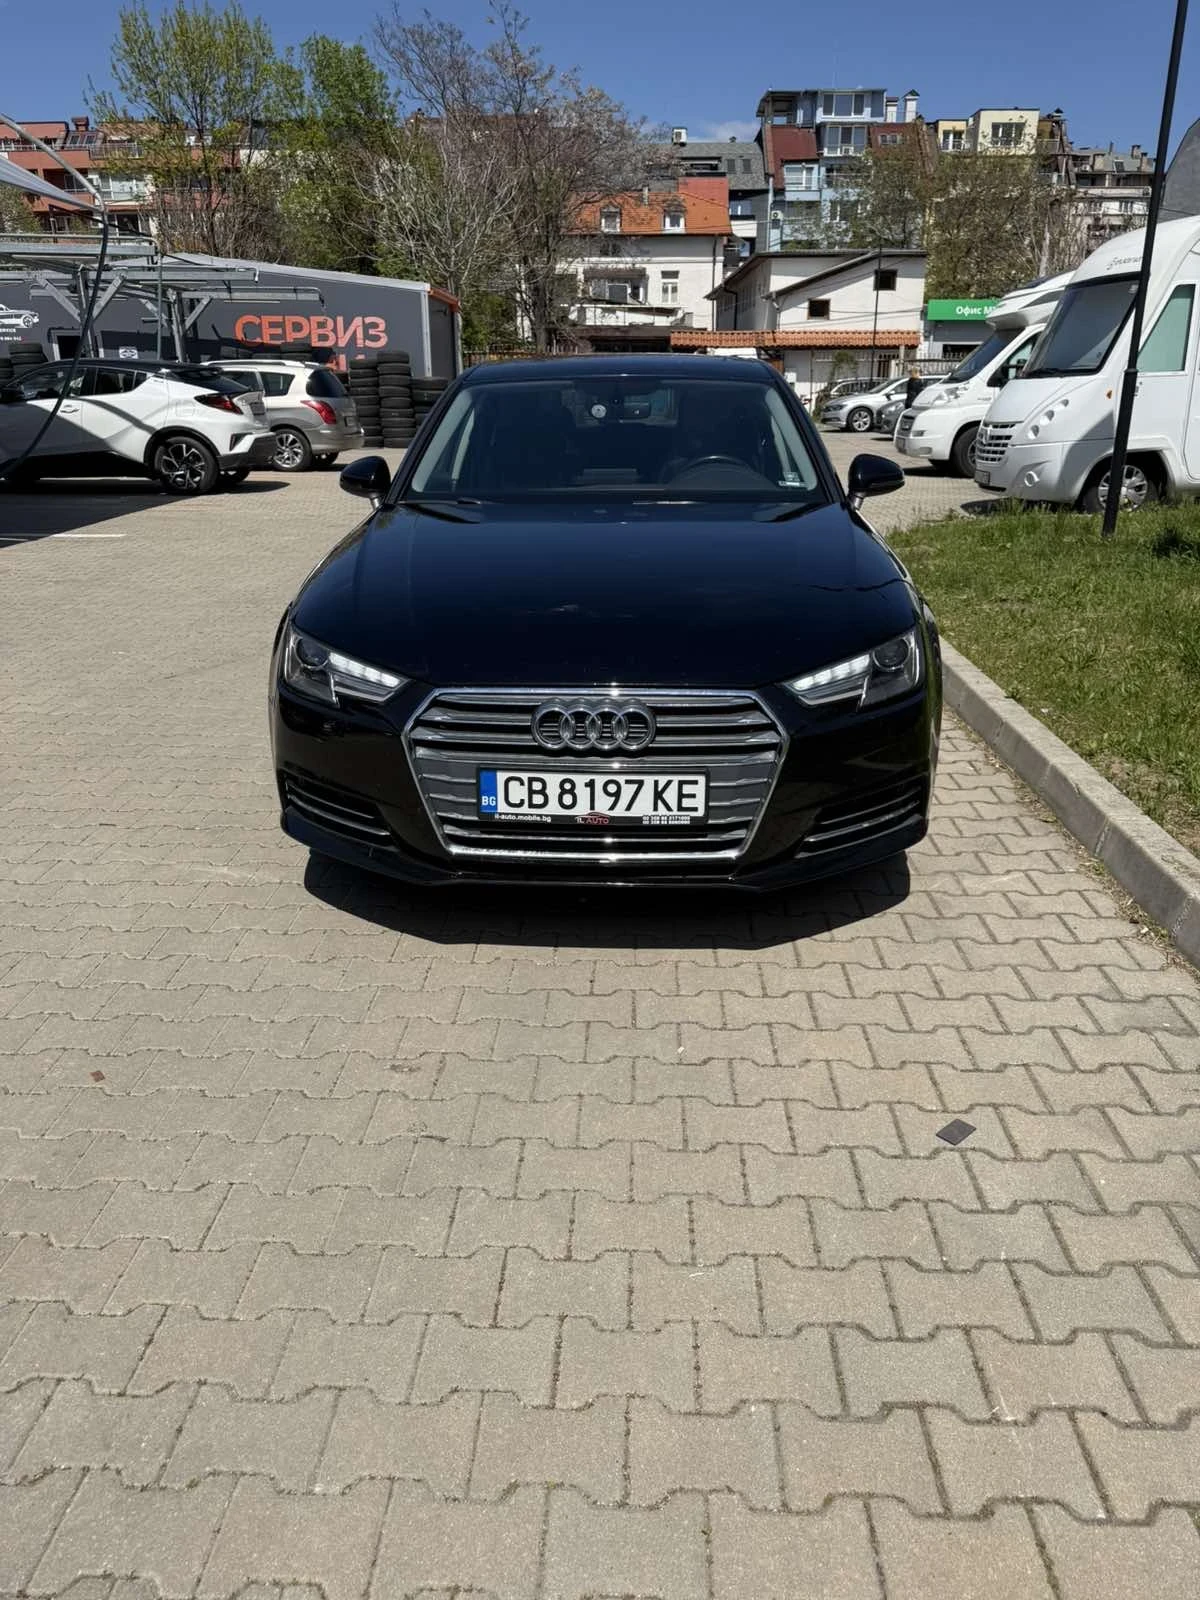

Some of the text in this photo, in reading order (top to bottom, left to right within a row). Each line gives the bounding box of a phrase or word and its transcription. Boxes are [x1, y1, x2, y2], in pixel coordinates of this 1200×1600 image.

[956, 305, 982, 316] Офис
[235, 315, 388, 348] СЕРВИЗ
[557, 778, 644, 811] 8197
[481, 796, 496, 806] BG
[586, 816, 609, 824] AUTO
